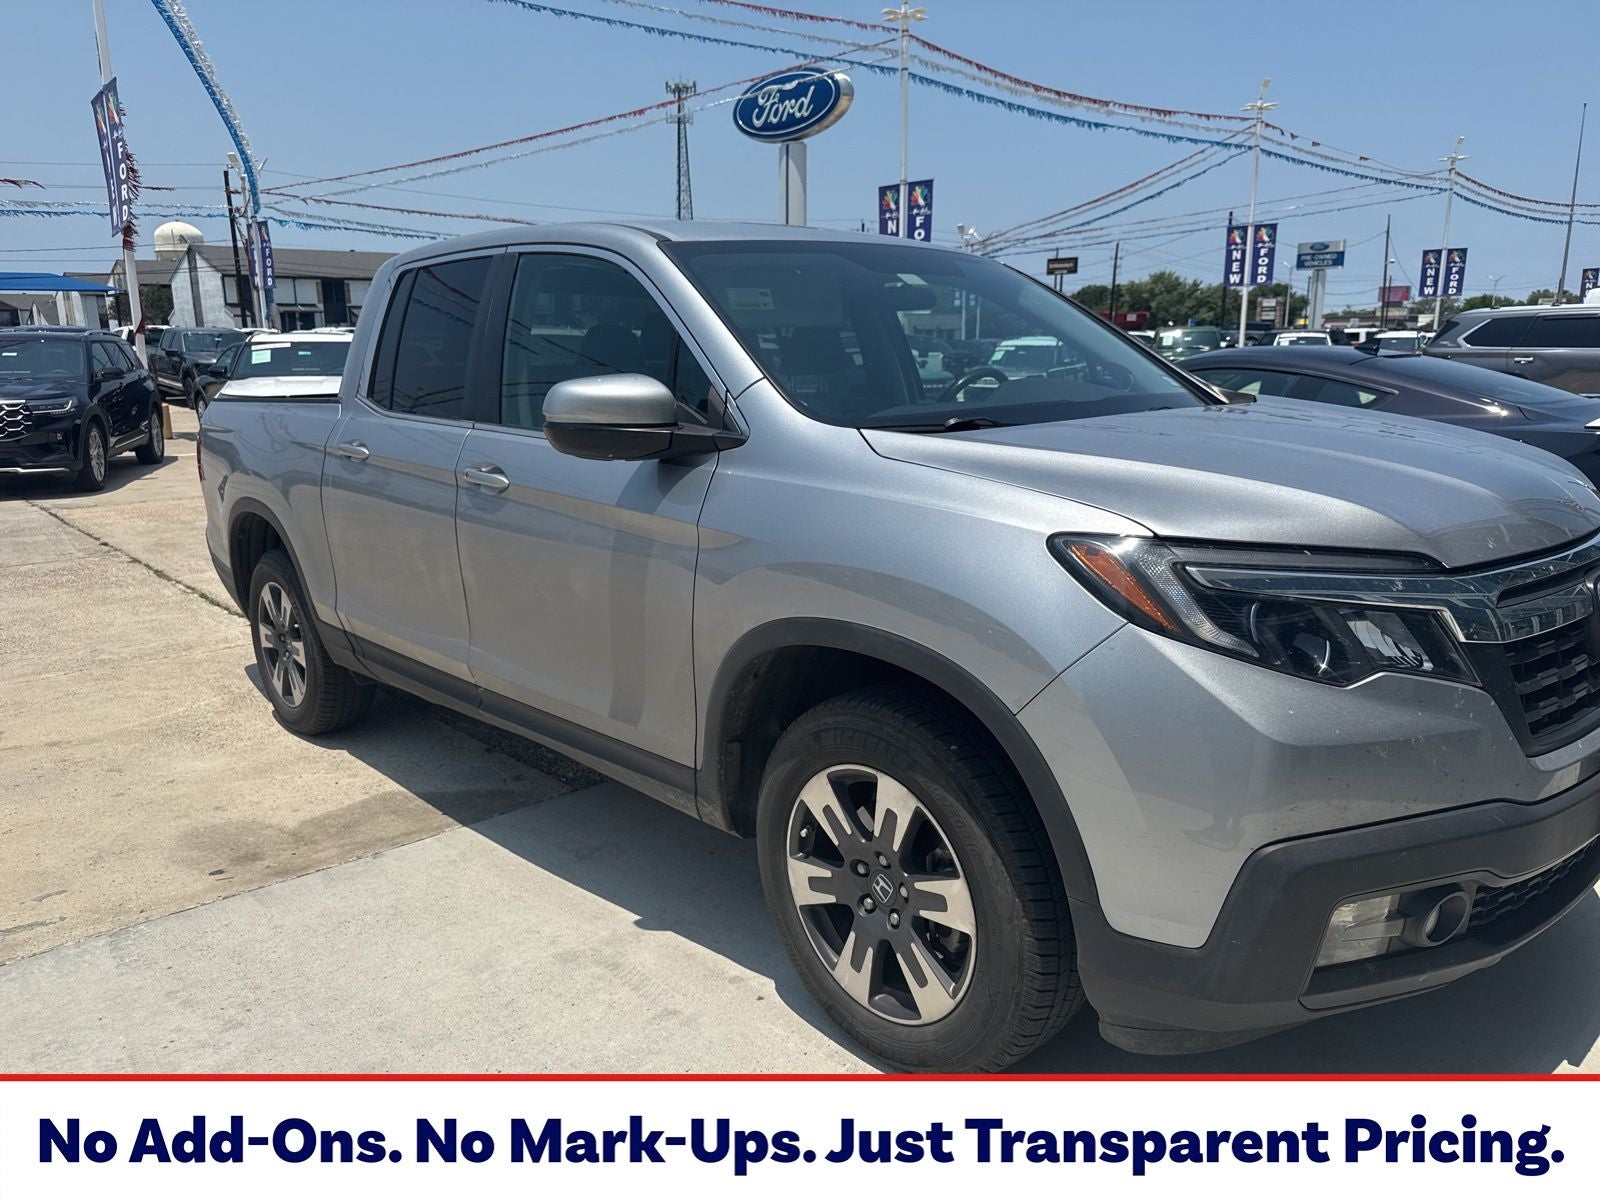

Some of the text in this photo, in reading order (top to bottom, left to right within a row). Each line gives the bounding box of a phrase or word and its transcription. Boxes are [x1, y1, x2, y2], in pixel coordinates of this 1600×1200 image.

[752, 80, 816, 128] Ford
[117, 141, 129, 221] FORD
[913, 216, 925, 240] FO
[265, 248, 273, 286] FORD
[1229, 249, 1242, 284] NEW
[1256, 248, 1269, 284] FORD
[1423, 267, 1436, 295] NEW
[1448, 266, 1460, 295] FORD
